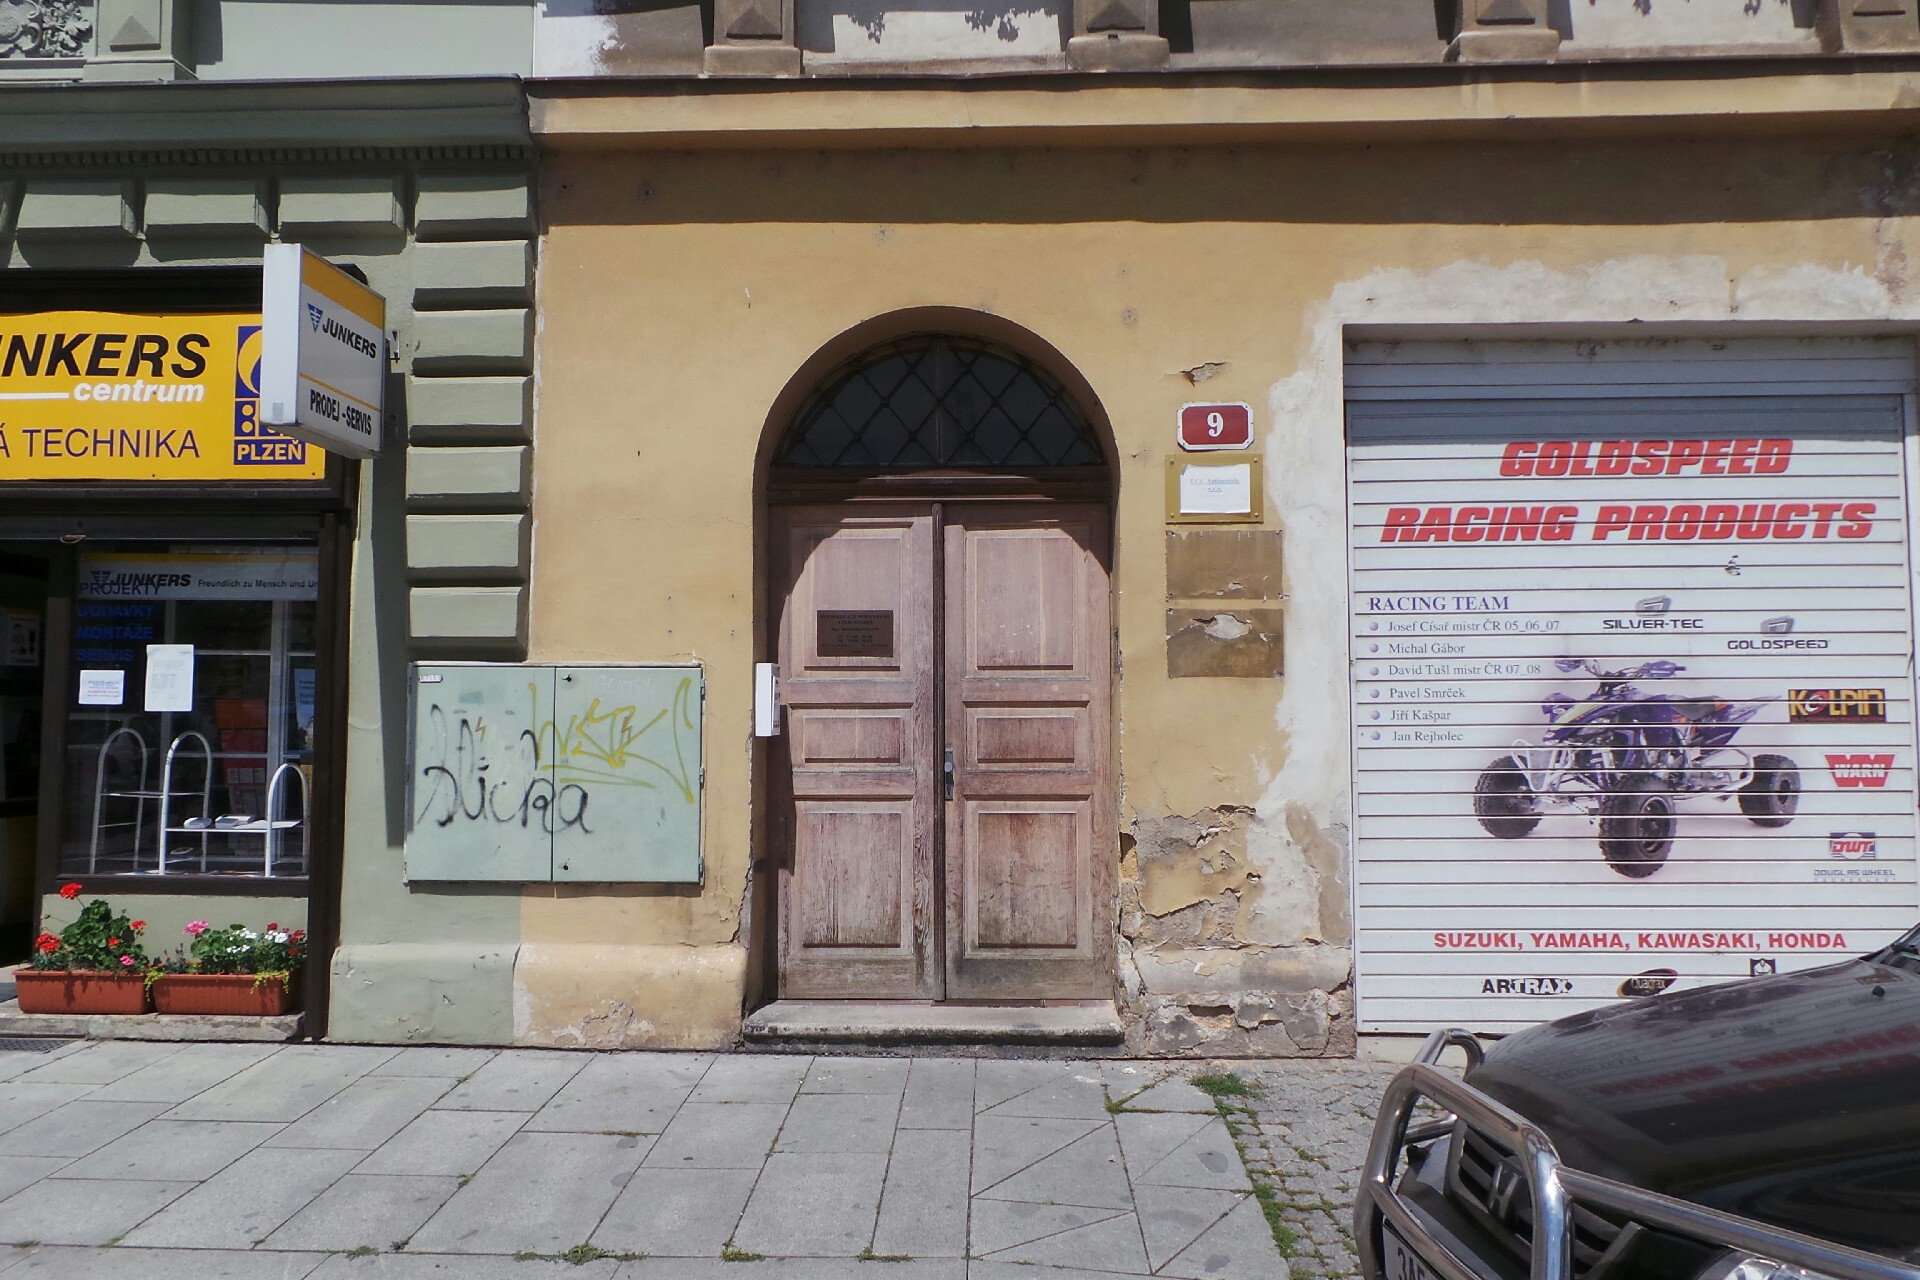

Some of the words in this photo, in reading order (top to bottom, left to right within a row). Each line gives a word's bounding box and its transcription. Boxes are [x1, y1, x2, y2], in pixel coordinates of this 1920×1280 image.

[322, 317, 377, 359] JUNKERS
[0, 333, 210, 378] NKERS
[74, 379, 204, 402] centrum
[310, 389, 340, 422] PRODEJ
[1206, 412, 1224, 437] 9
[22, 428, 200, 458] TECHNIKA
[236, 439, 302, 461] PLZEŇ
[1500, 438, 1794, 477] GOLDSPEED
[1380, 507, 1579, 543] RACING
[1591, 503, 1877, 542] PRODUCTS
[110, 573, 192, 588] JUNKERS
[198, 579, 241, 588] Freundlich
[255, 579, 287, 588] Mensch
[289, 580, 304, 588] und
[79, 582, 161, 596] PROJEKTY
[1369, 596, 1447, 611] RACING
[1452, 596, 1510, 610] TEAM
[1388, 621, 1417, 632] Josef
[1419, 620, 1449, 632] Císař
[1452, 621, 1480, 631] mistr
[1483, 618, 1501, 631] ČR
[1504, 620, 1560, 633] 05_06_07
[1602, 618, 1704, 630] SILVER-TEC
[1388, 642, 1427, 654] Michal
[1430, 642, 1466, 654] Gábor
[1727, 639, 1829, 650] GOLDSPEED
[77, 648, 134, 662] SERVIS
[1388, 664, 1422, 675] David
[1425, 663, 1450, 675] Tušl
[1453, 664, 1481, 675] mistr
[1484, 662, 1502, 675] ČR
[1505, 664, 1541, 677] 07_08
[1389, 687, 1420, 698] Pavel
[1423, 687, 1466, 698] Smrček
[1390, 709, 1409, 721] Jiří
[1412, 709, 1452, 723] Kašpar
[1392, 731, 1411, 742] Jan
[1414, 731, 1464, 743] Rejholec
[1834, 763, 1886, 778] WARN
[1830, 840, 1874, 853] DWT
[1434, 932, 1524, 950] SUZUKI,
[1530, 932, 1631, 951] YAMAHA,
[1638, 932, 1761, 951] KAWASAKI,
[1768, 932, 1848, 948] HONDA
[1481, 977, 1570, 995] ARTRAX
